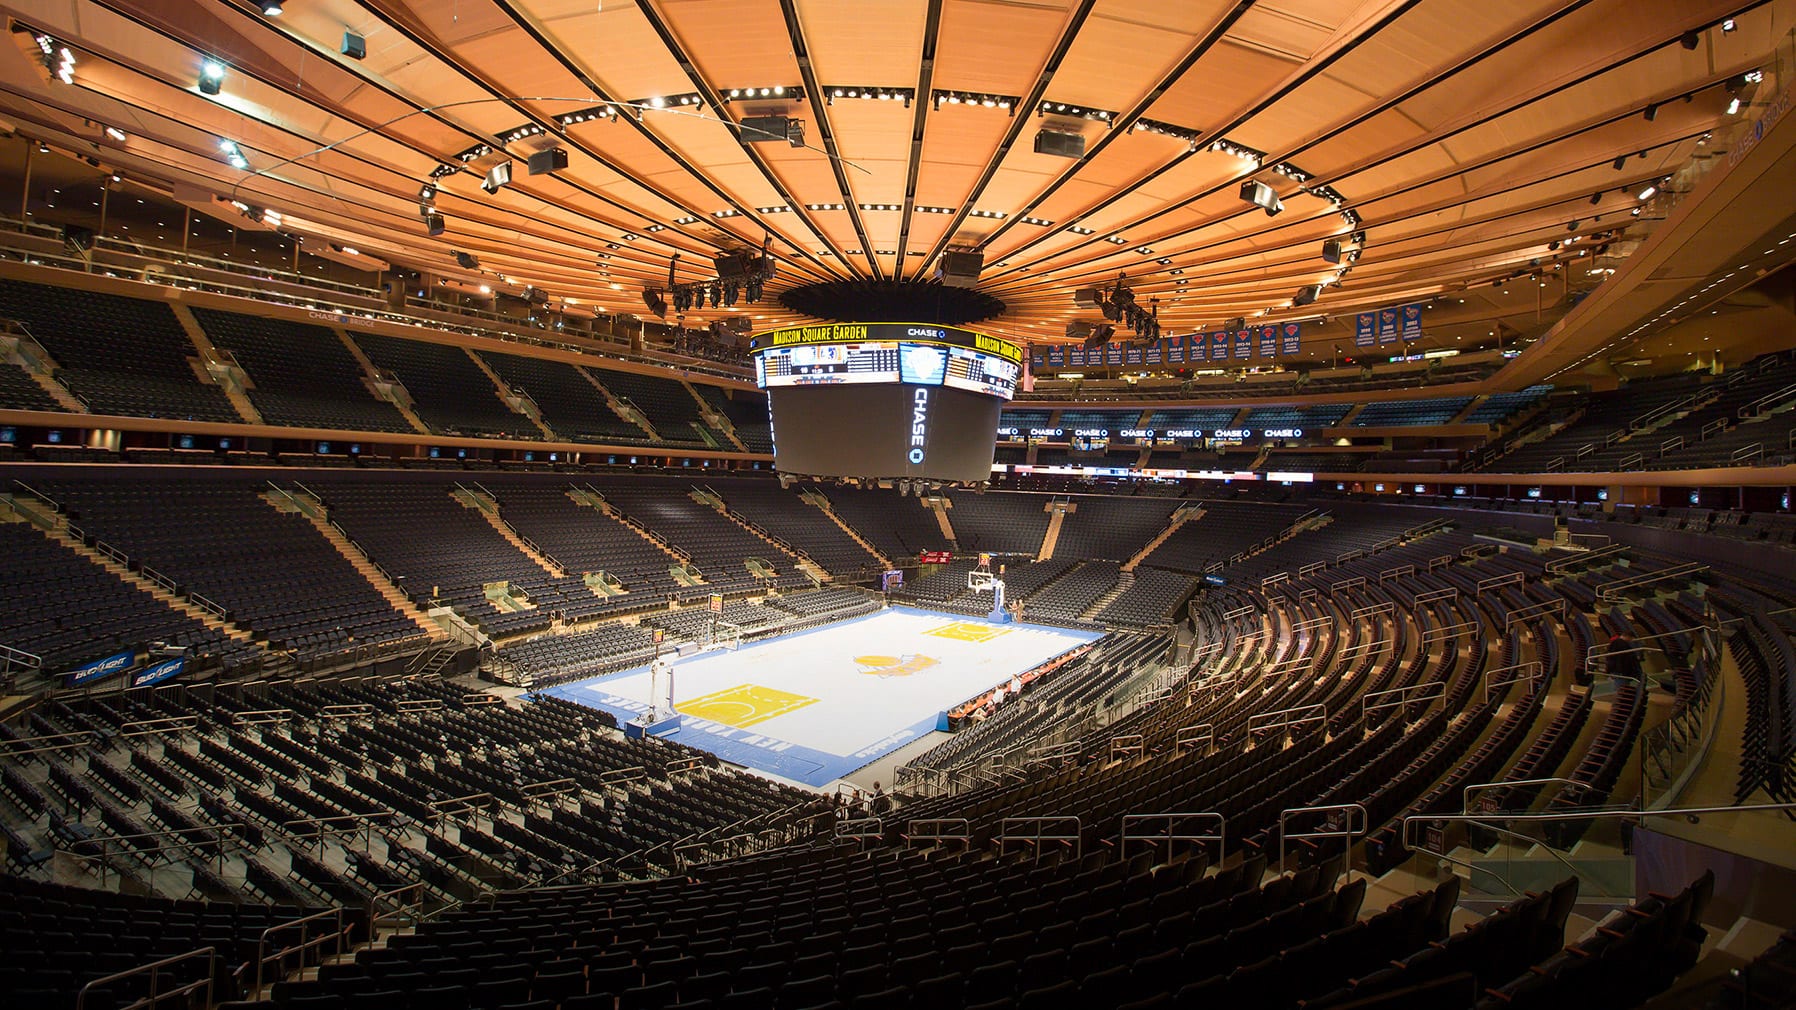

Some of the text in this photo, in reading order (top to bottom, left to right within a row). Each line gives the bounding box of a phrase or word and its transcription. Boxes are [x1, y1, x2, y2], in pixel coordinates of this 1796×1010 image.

[308, 311, 375, 328] CHASE BRIDGE
[907, 328, 939, 337] CHASE
[912, 388, 928, 447] CHASE
[1074, 429, 1100, 437] CHASE
[1214, 429, 1243, 437] CHASE
[1264, 429, 1294, 437] CHASE
